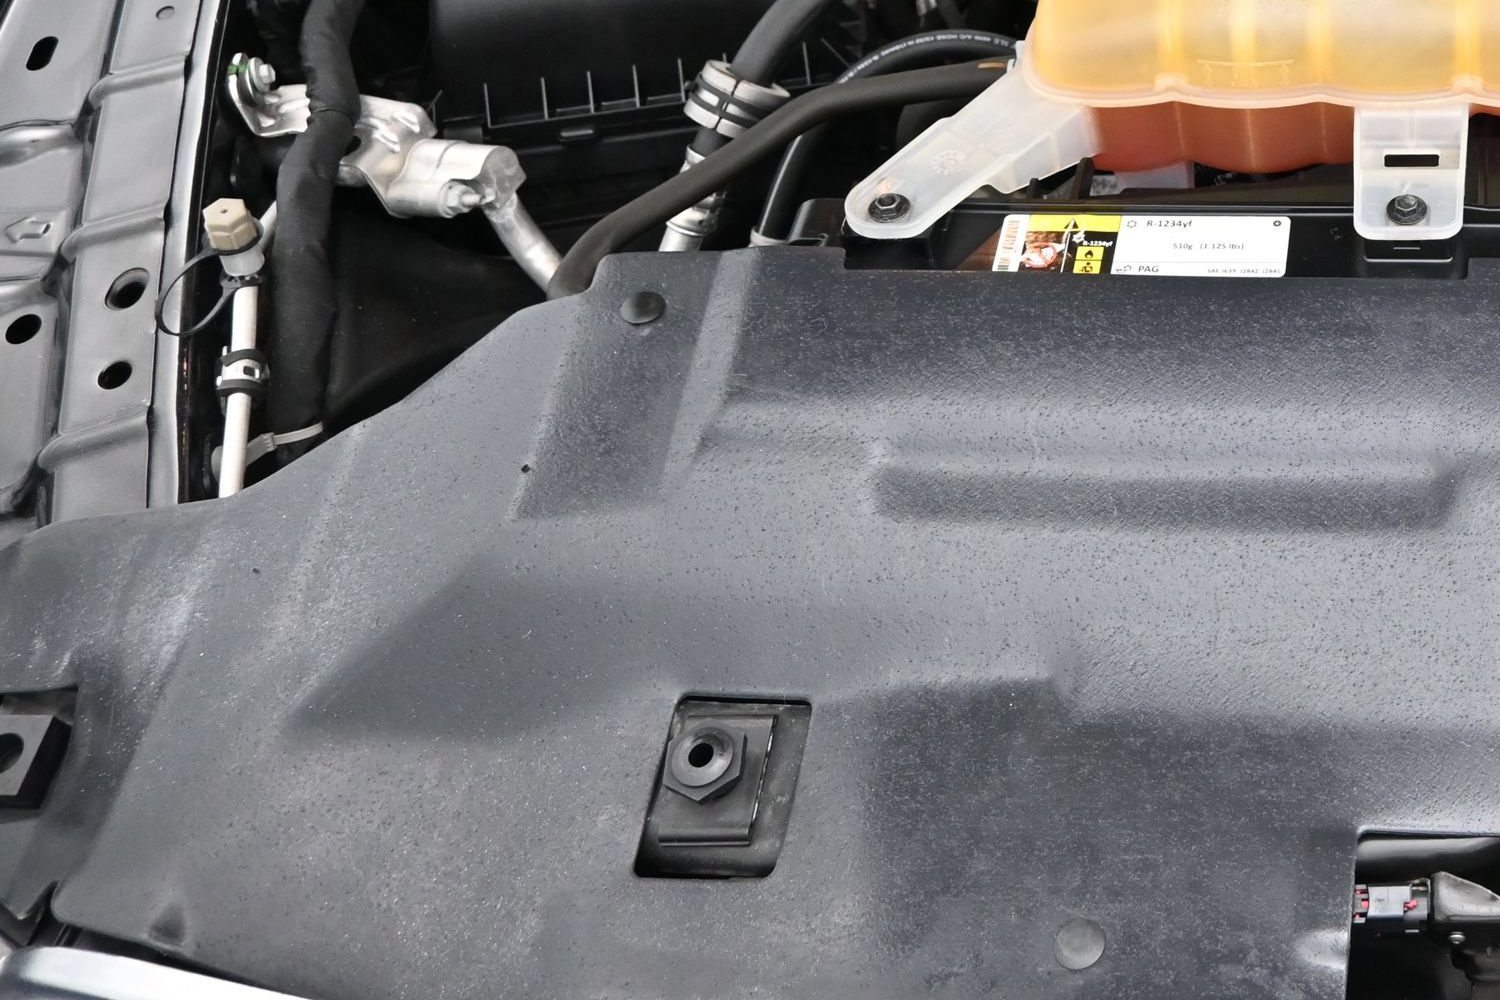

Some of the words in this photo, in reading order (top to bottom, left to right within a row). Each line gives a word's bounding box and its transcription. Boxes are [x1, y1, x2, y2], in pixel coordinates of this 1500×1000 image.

[1146, 218, 1193, 229] R-1234yf
[1082, 240, 1114, 248] R-1234yf
[1172, 242, 1193, 251] 510g
[1138, 264, 1159, 273] PAG
